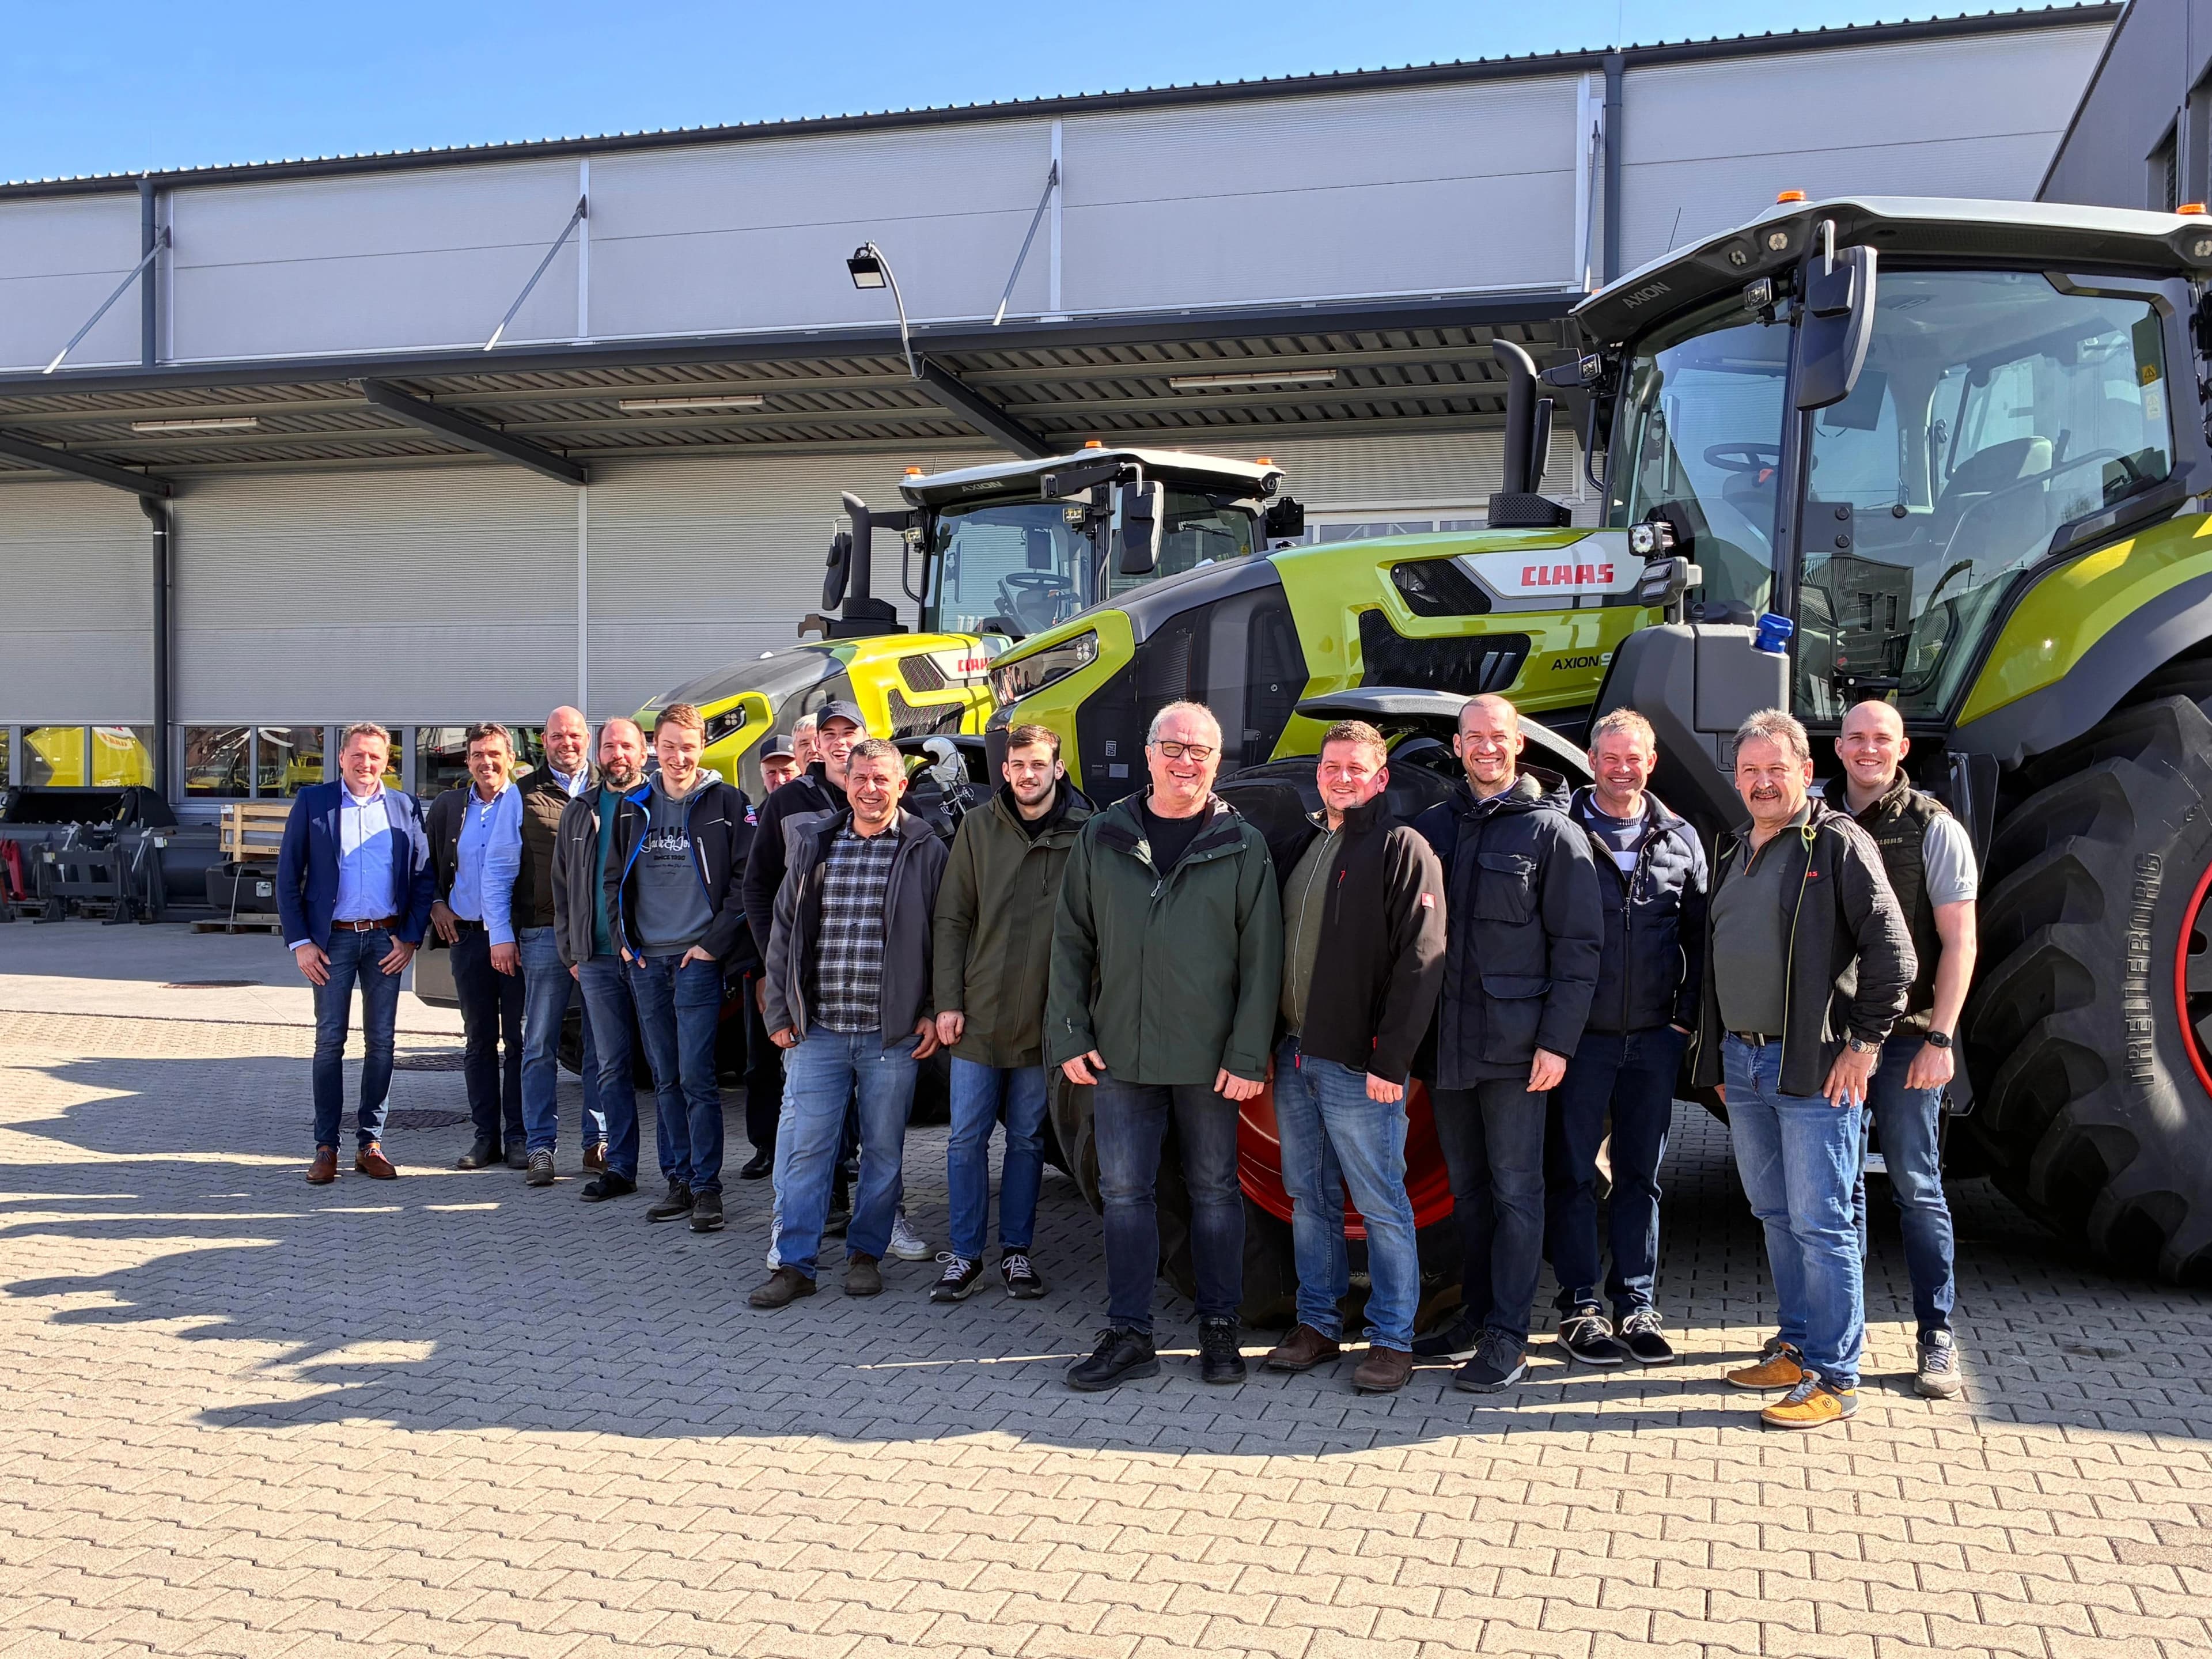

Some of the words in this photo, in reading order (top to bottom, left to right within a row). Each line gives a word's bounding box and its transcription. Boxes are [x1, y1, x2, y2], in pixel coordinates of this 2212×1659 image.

[1622, 282, 1672, 309] AXION
[961, 481, 1005, 493] AXION
[1521, 564, 1613, 586] CLAAS
[958, 657, 995, 672] CLAA
[1551, 655, 1600, 671] AXION
